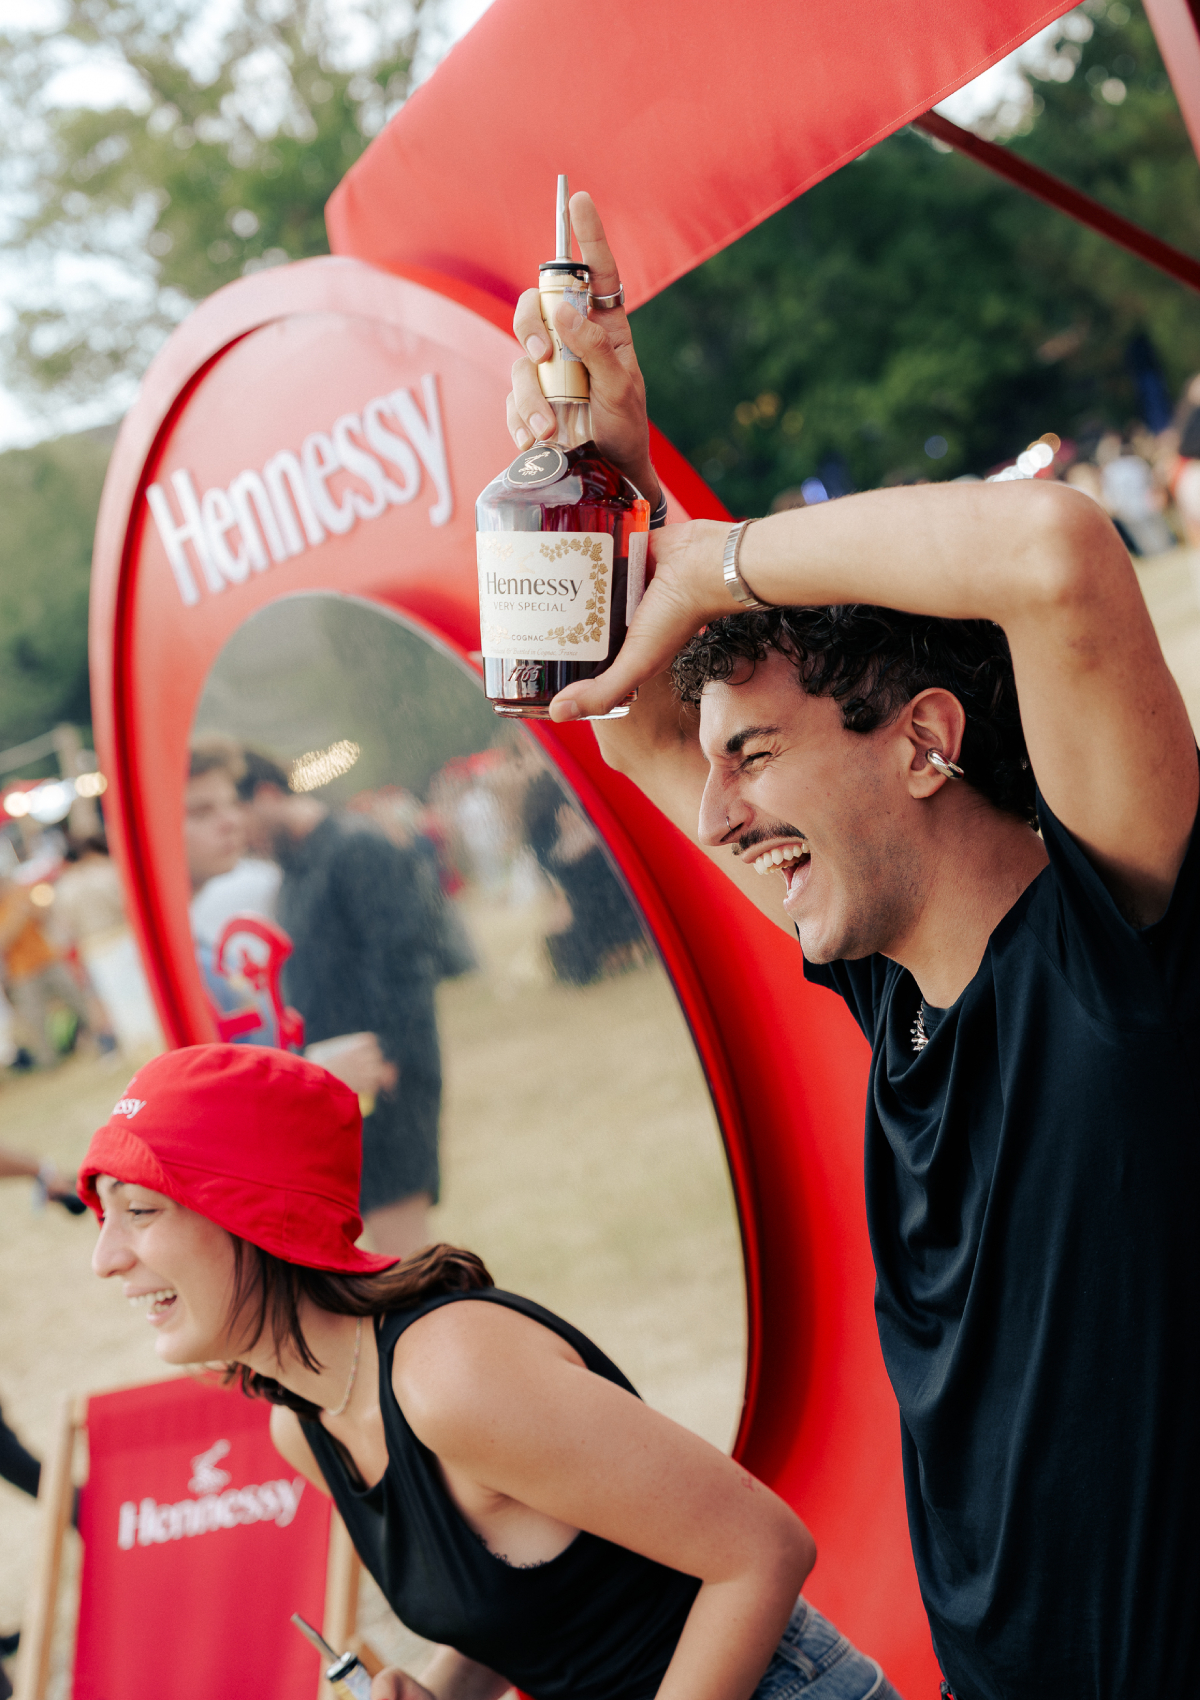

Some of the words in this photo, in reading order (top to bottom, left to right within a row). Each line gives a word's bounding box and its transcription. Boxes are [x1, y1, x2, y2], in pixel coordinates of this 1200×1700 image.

[145, 372, 453, 607] Hennessy
[486, 572, 583, 602] Hennessy
[493, 601, 515, 611] VERY
[517, 602, 567, 613] SPECIAL
[511, 634, 544, 642] COGNAC
[508, 664, 544, 682] 1765
[117, 1475, 306, 1551] Hennessy
